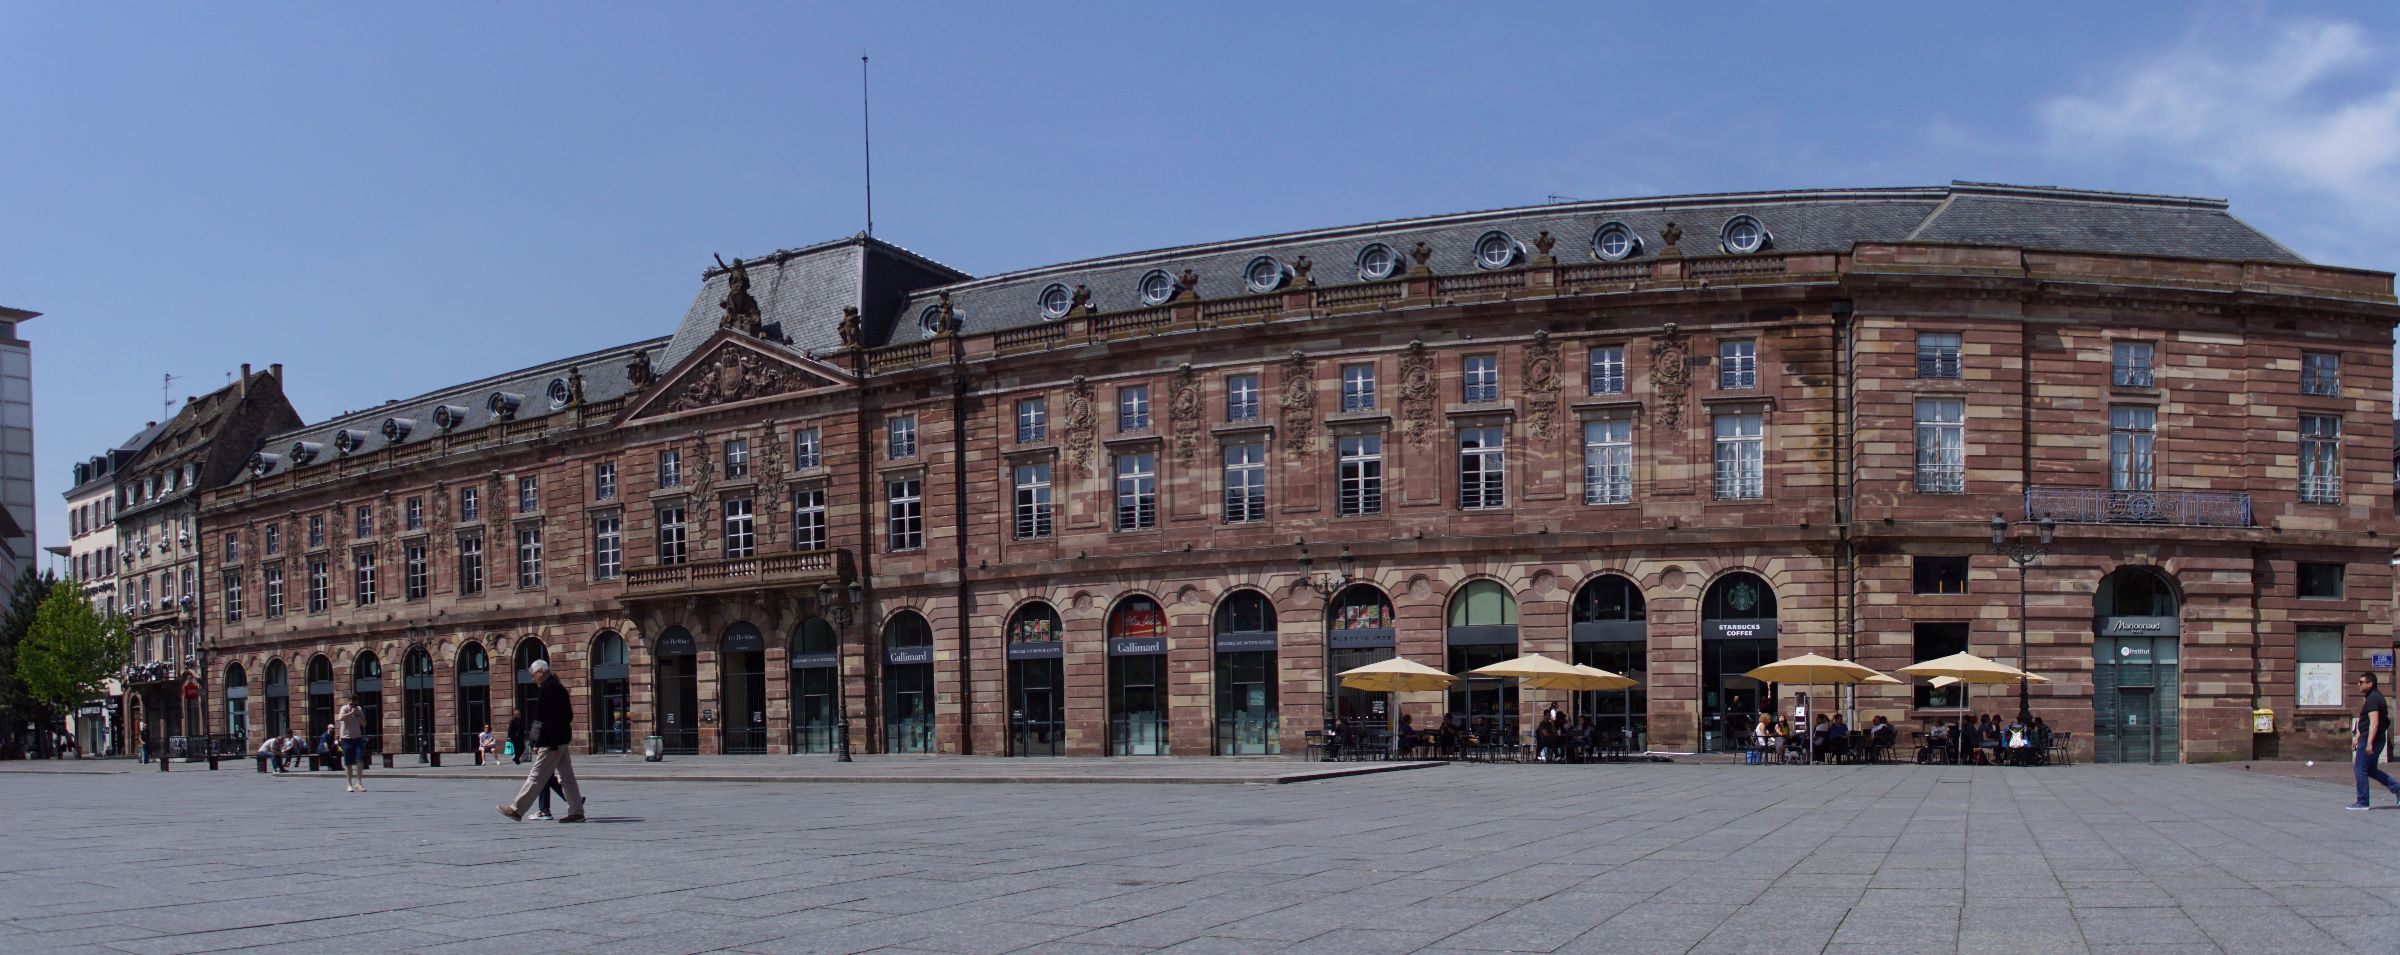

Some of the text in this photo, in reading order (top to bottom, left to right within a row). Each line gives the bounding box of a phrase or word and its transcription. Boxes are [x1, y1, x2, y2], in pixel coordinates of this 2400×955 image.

[2113, 620, 2160, 631] Marionnaud
[1117, 641, 1160, 653] Gallimard
[890, 651, 927, 662] Gallimard
